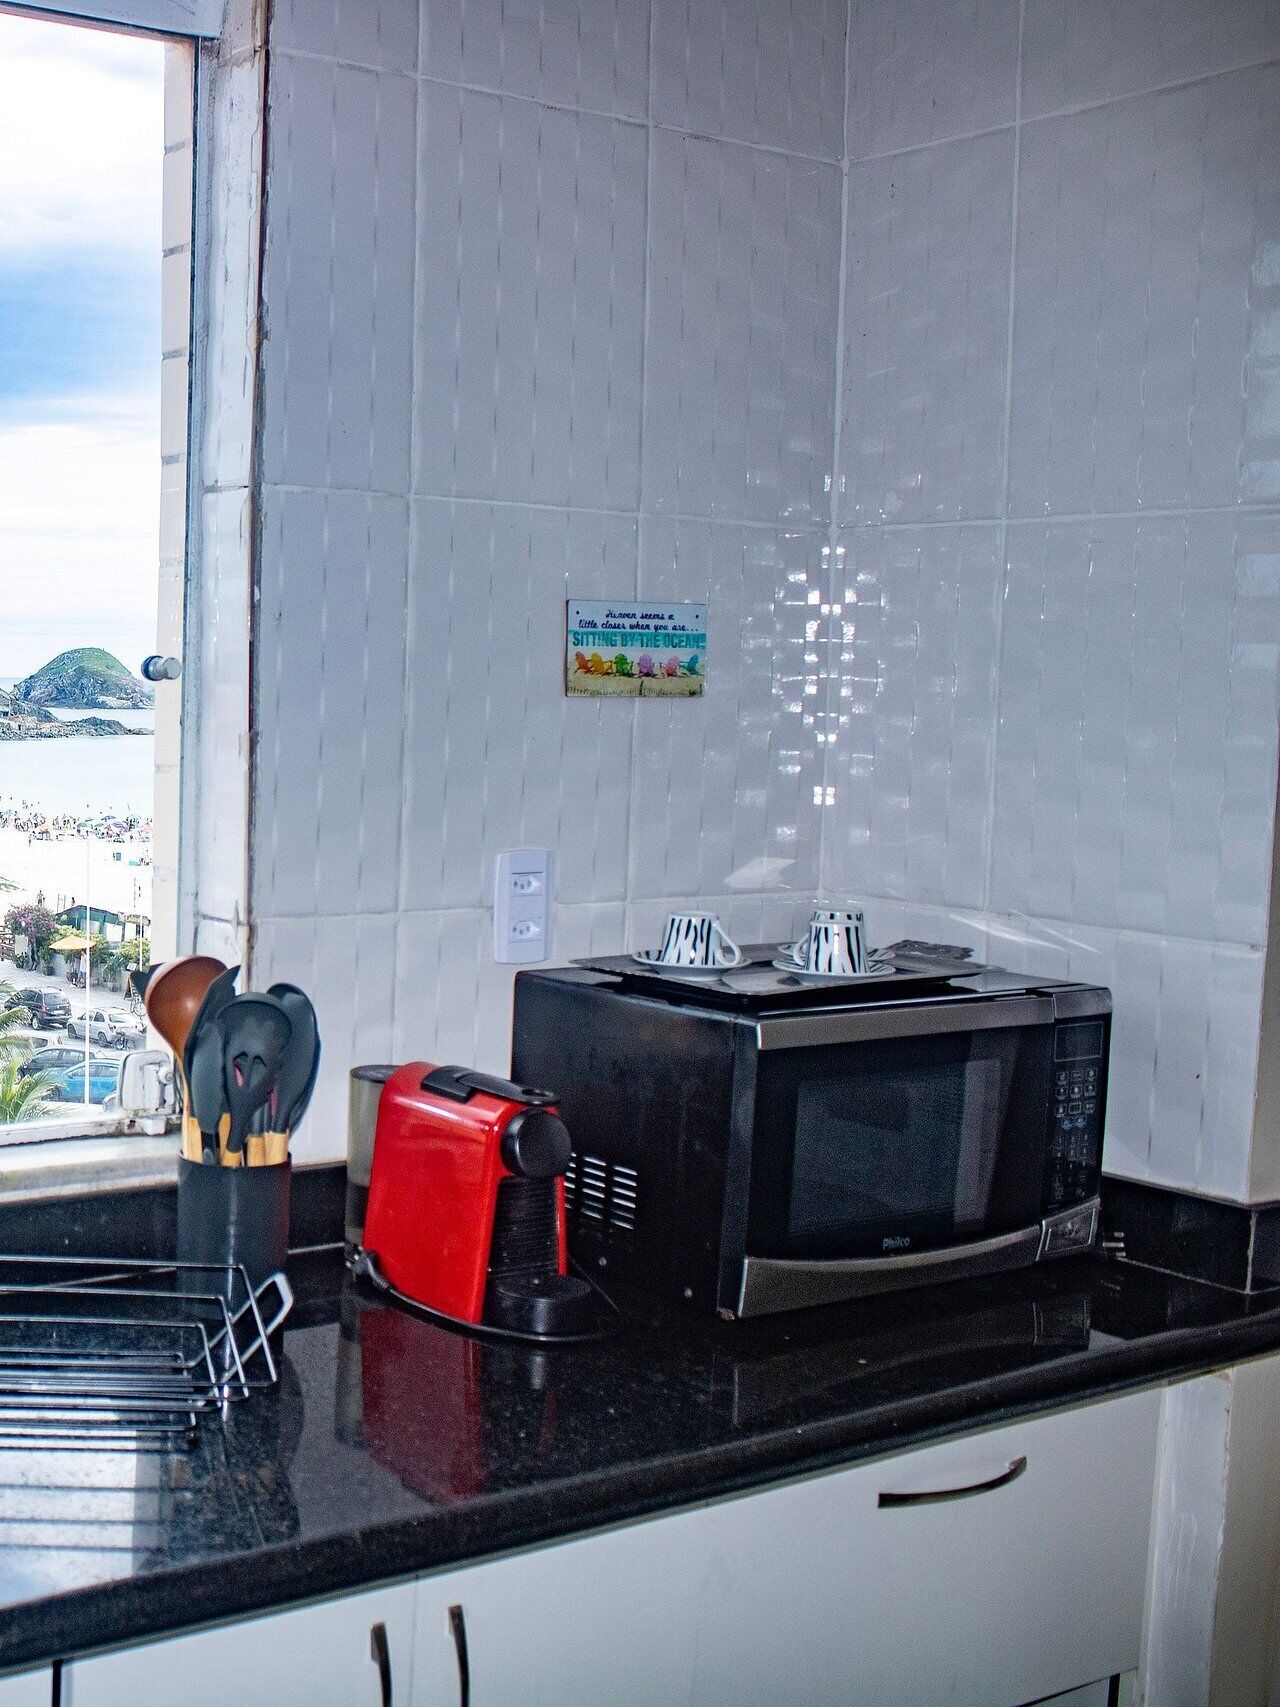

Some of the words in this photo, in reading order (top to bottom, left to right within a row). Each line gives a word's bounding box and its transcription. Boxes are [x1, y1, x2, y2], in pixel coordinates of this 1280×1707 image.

[640, 612, 665, 620] seems
[667, 613, 675, 621] a
[578, 619, 598, 629] little
[601, 620, 627, 630] closer
[628, 621, 651, 630] when
[653, 624, 669, 633] you
[573, 630, 618, 647] SITTING
[619, 632, 638, 648] BY
[638, 632, 660, 648] THE
